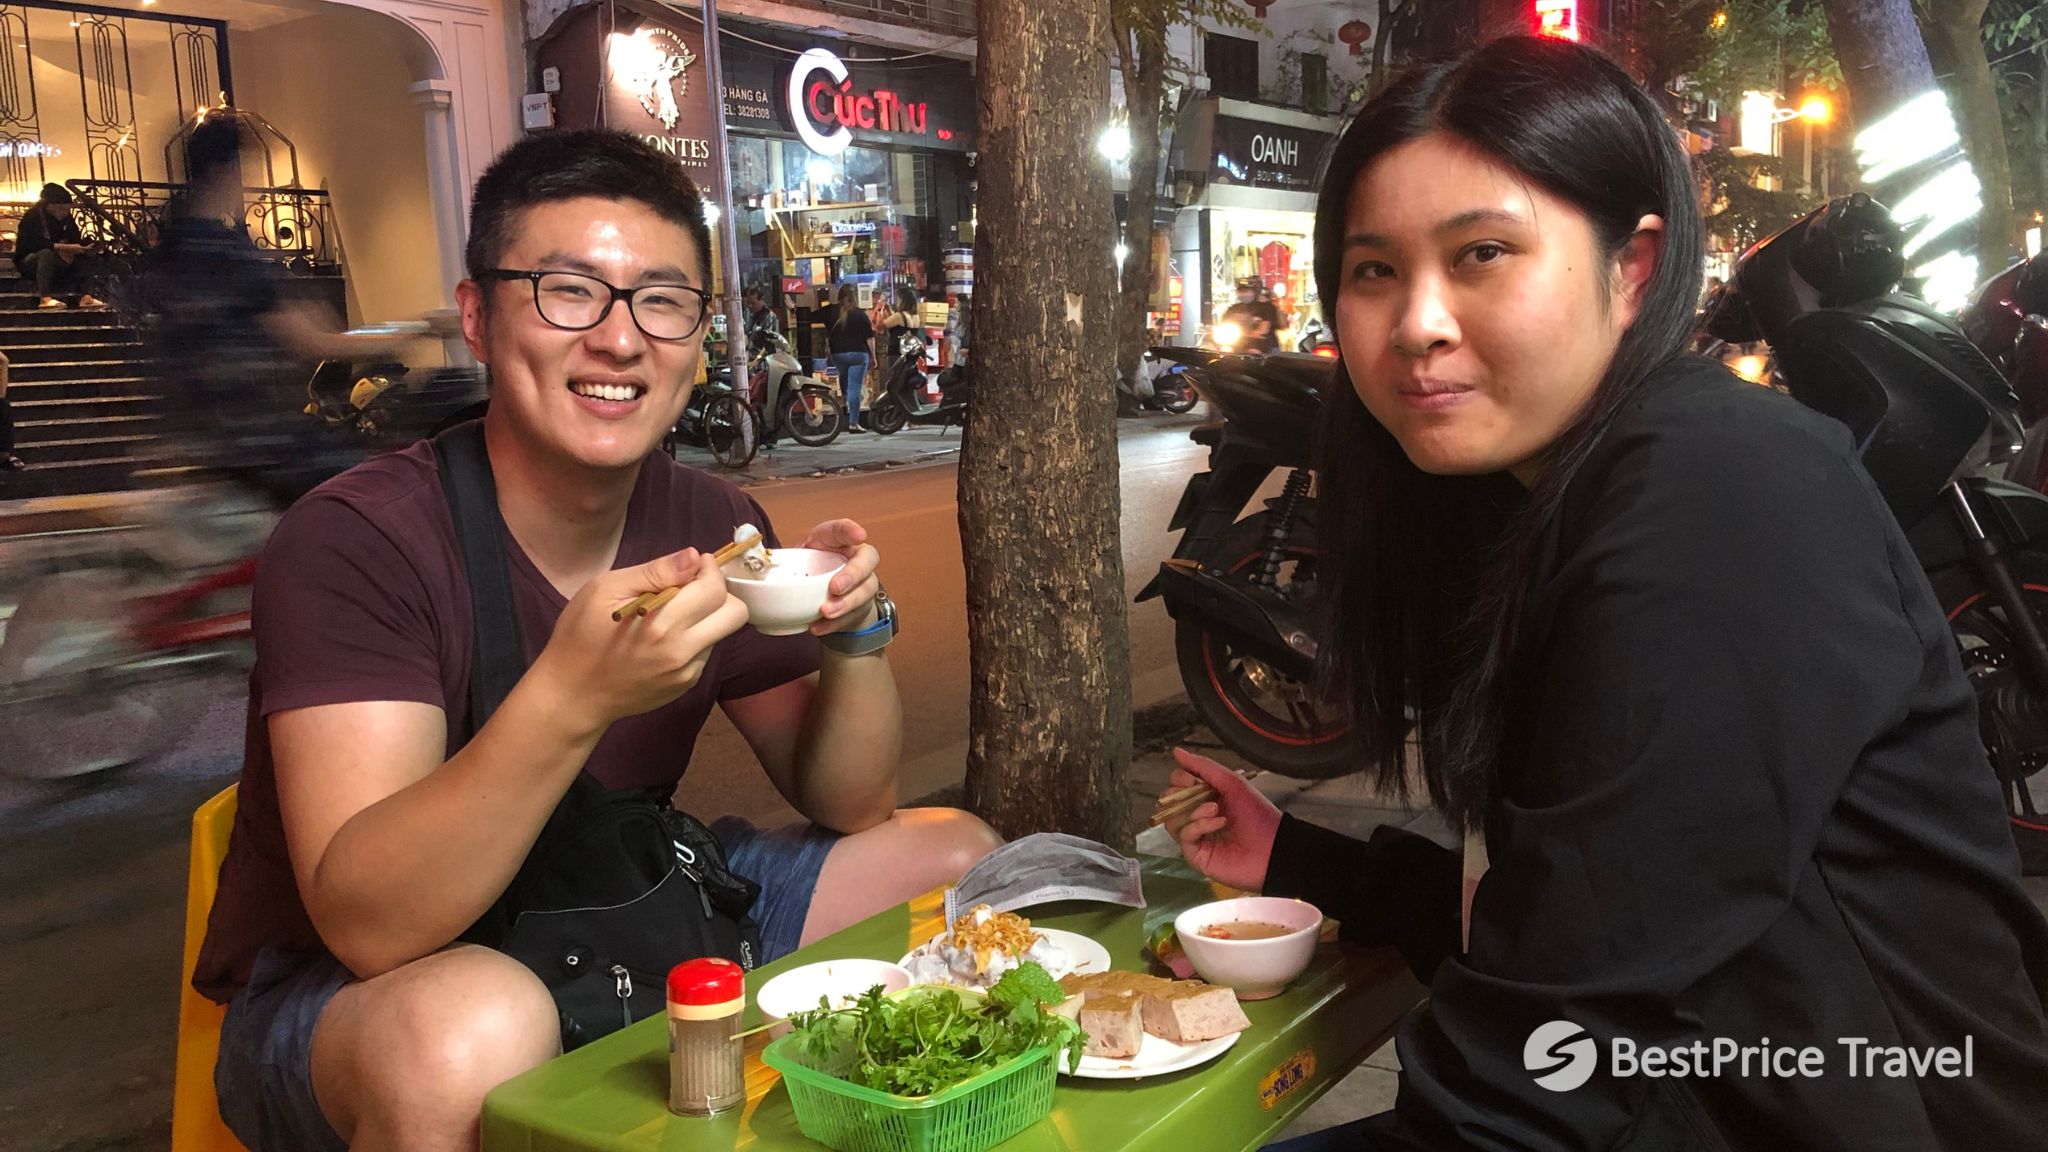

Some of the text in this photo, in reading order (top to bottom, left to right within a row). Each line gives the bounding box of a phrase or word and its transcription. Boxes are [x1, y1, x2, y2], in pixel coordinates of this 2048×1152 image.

[728, 85, 754, 101] HÀNG
[755, 88, 769, 104] GÀ
[639, 134, 709, 159] ONTES
[1251, 134, 1298, 167] OANH
